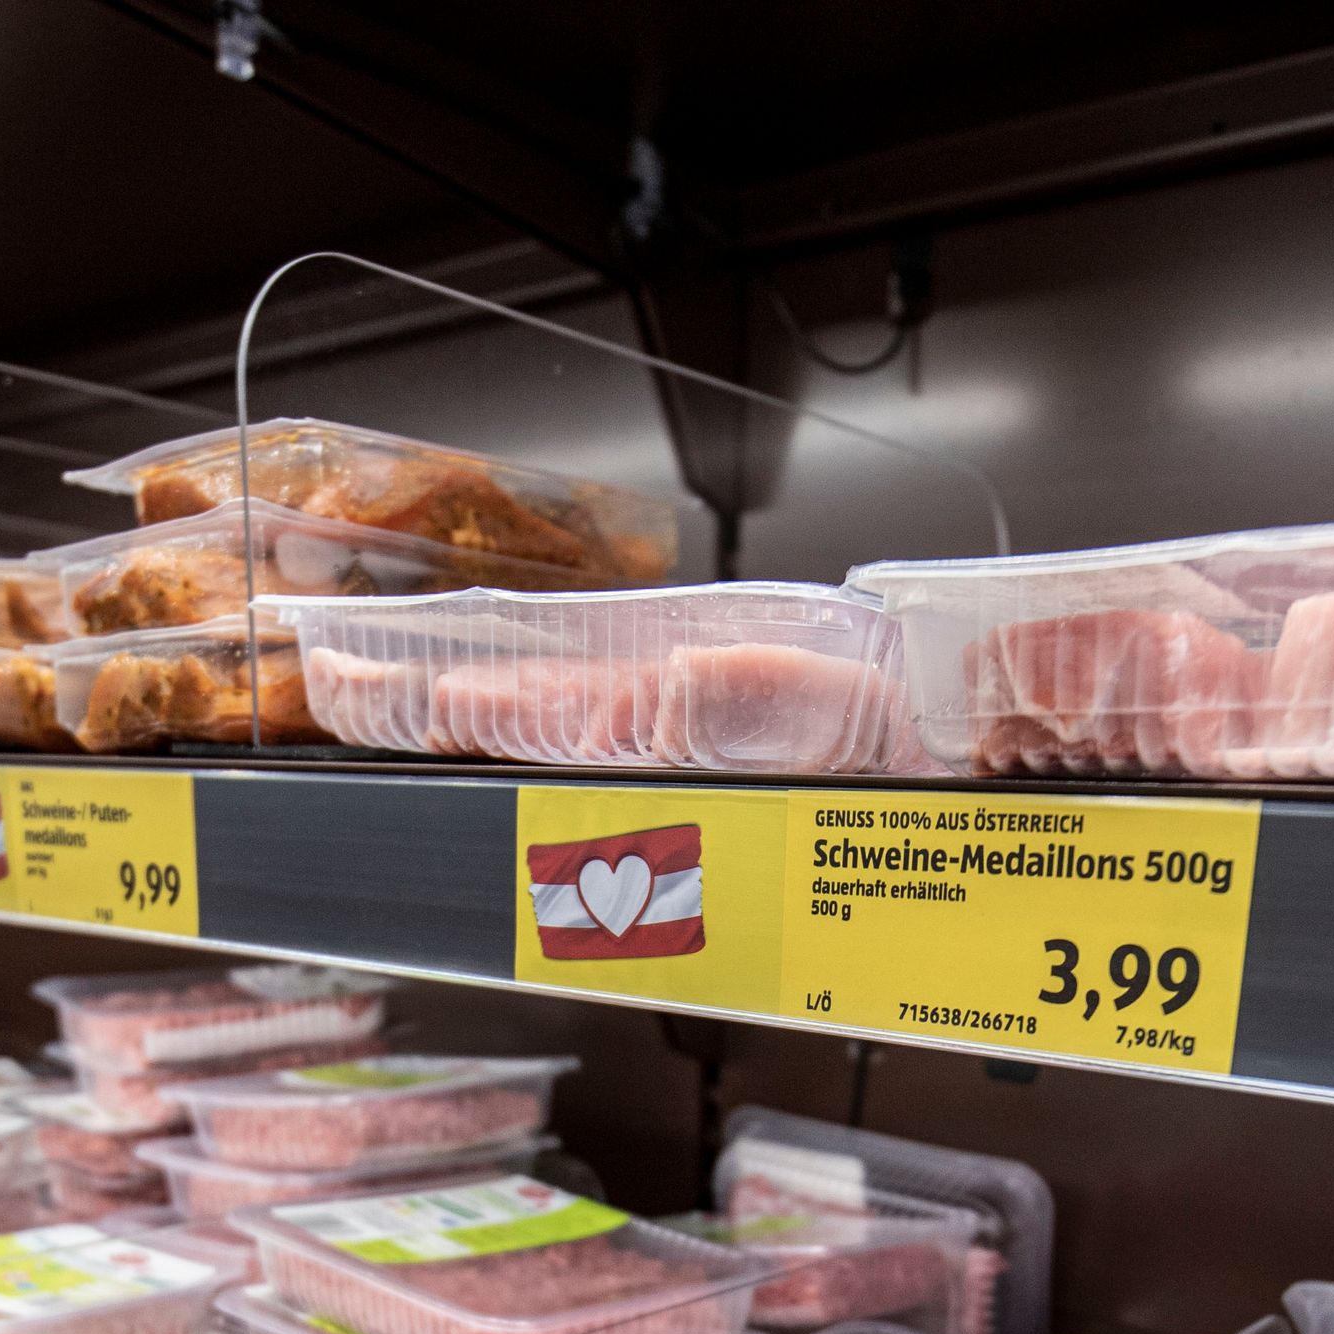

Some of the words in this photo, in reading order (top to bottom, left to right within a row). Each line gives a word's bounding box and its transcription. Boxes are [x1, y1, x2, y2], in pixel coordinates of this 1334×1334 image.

[89, 802, 132, 823] Puten-
[814, 809, 875, 829] GENUSS
[879, 810, 932, 831] 100%
[935, 812, 970, 831] AUS
[973, 807, 1085, 835] ÖSTERREICH
[24, 826, 87, 848] medaillons
[812, 838, 1136, 882] Schweine-Medaillons
[1144, 851, 1234, 895] 500g
[119, 860, 181, 912] 9,99
[811, 877, 887, 899] dauerhaft
[890, 882, 967, 903] erhältlich
[810, 899, 839, 918] 500
[841, 903, 852, 922] g
[1037, 938, 1201, 1022] 3,99
[805, 992, 832, 1013] L/Ö
[898, 1002, 1038, 1035] 715638/266718
[1115, 1025, 1197, 1056] 7,98/kg
